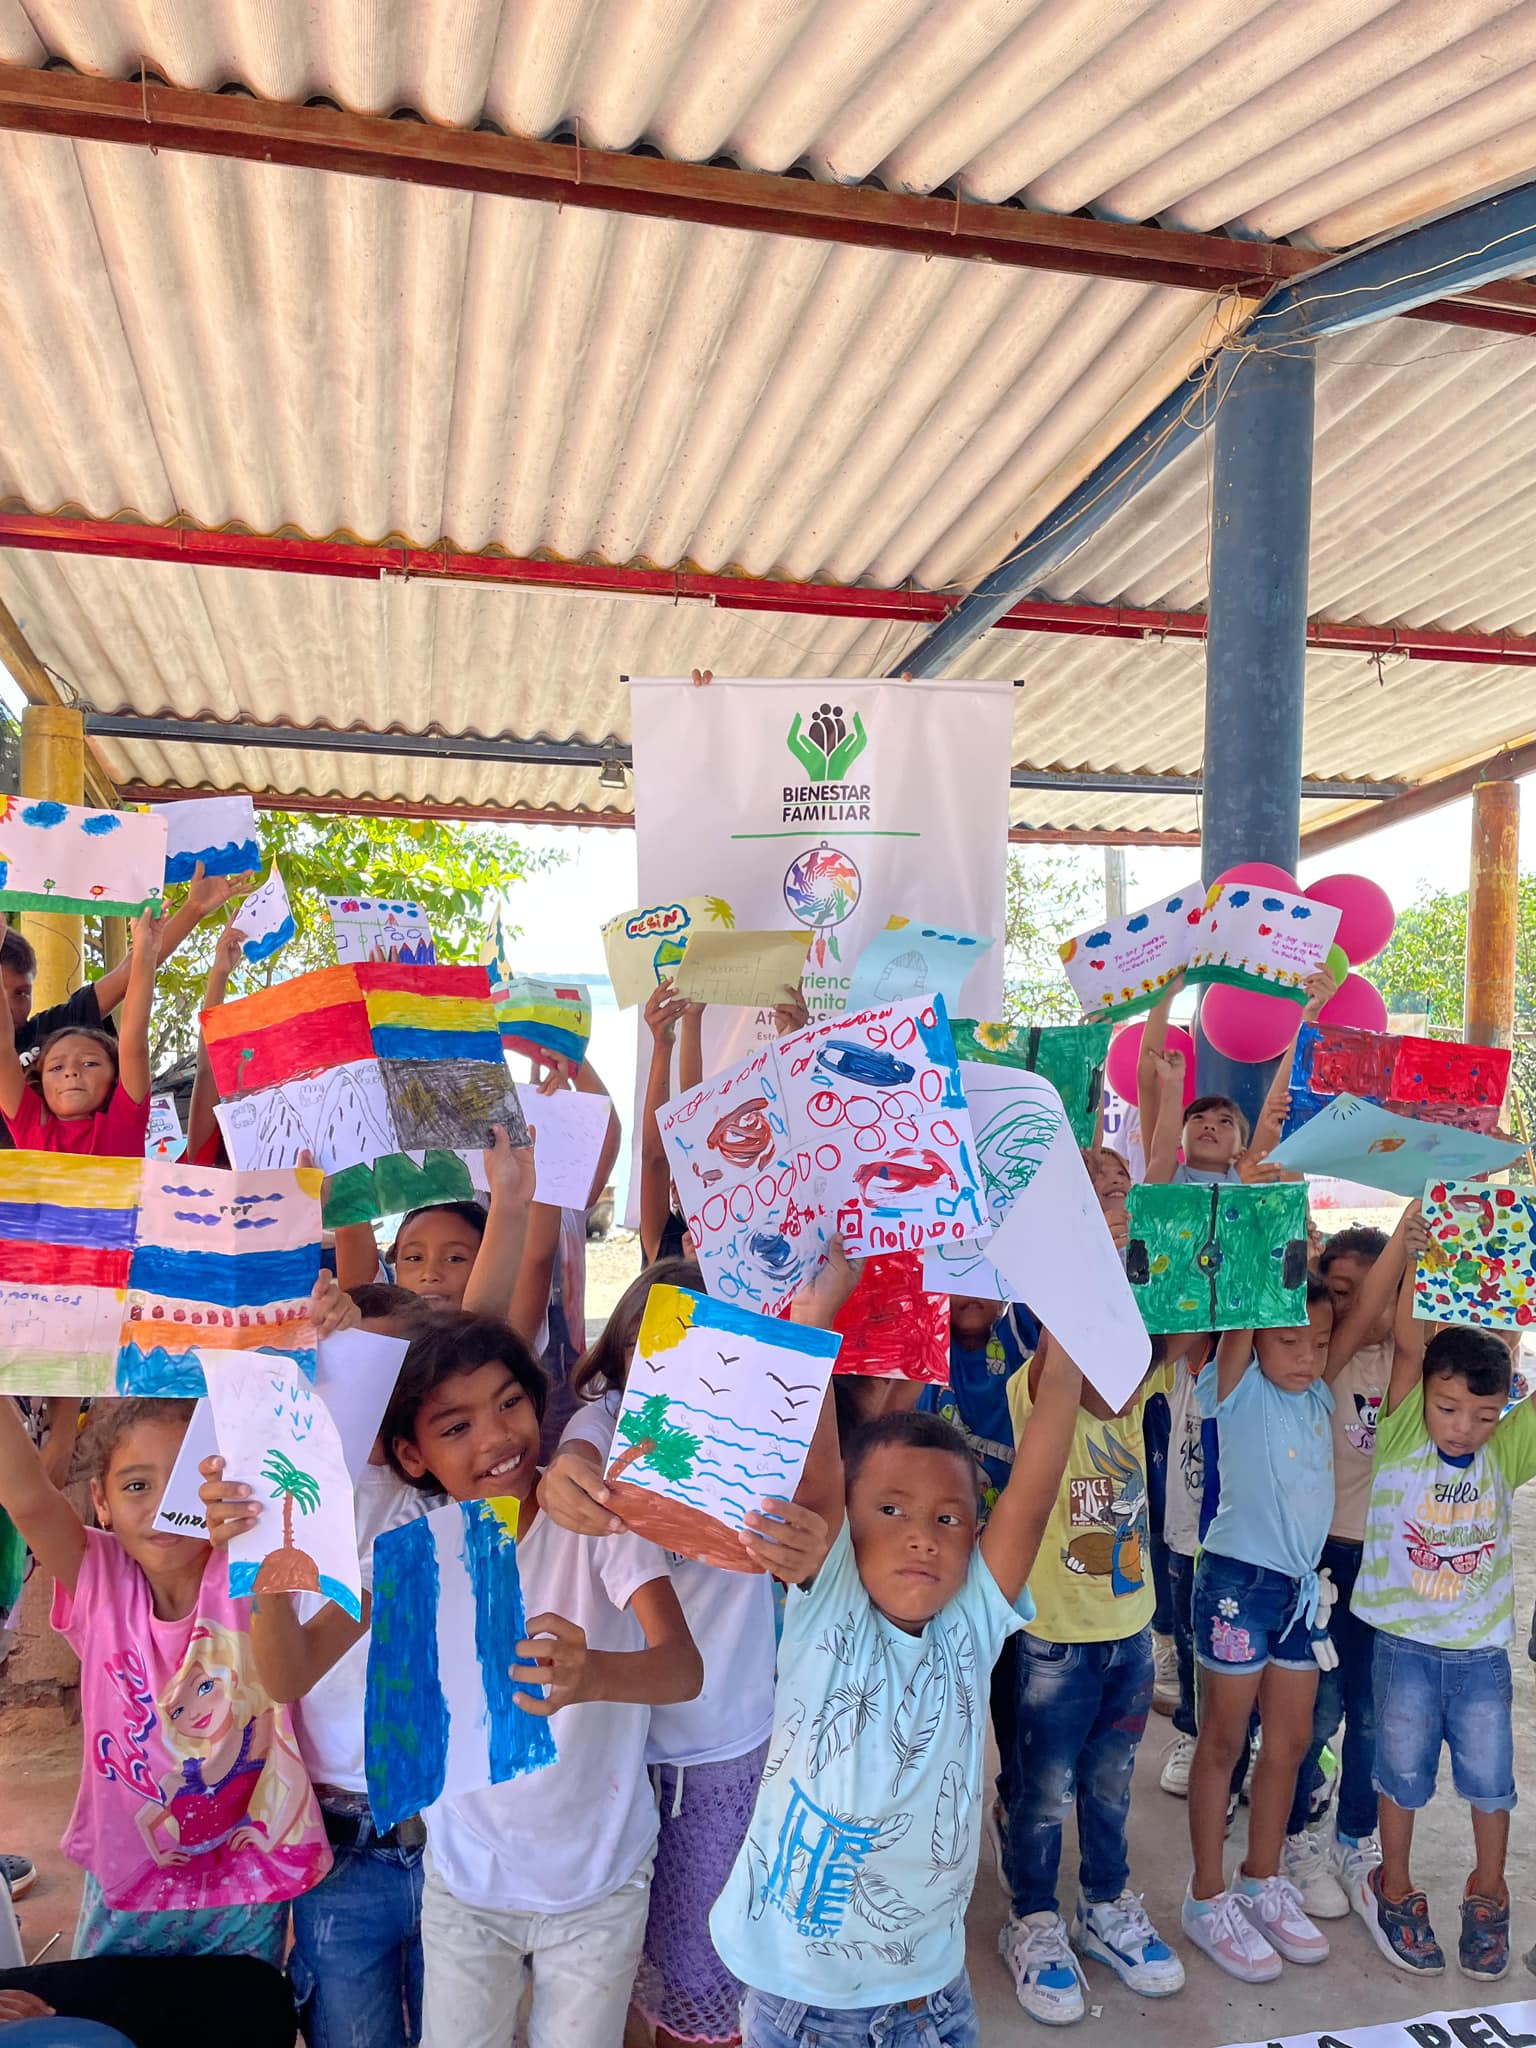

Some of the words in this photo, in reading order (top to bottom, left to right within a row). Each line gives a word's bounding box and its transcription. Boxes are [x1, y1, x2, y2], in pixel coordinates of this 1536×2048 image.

[783, 785, 870, 802] BIENESTAR
[782, 804, 870, 822] FAMILIAR
[1071, 1479, 1109, 1498] SPACE
[94, 1645, 167, 1807] Barbie
[797, 1922, 840, 1938] BOY
